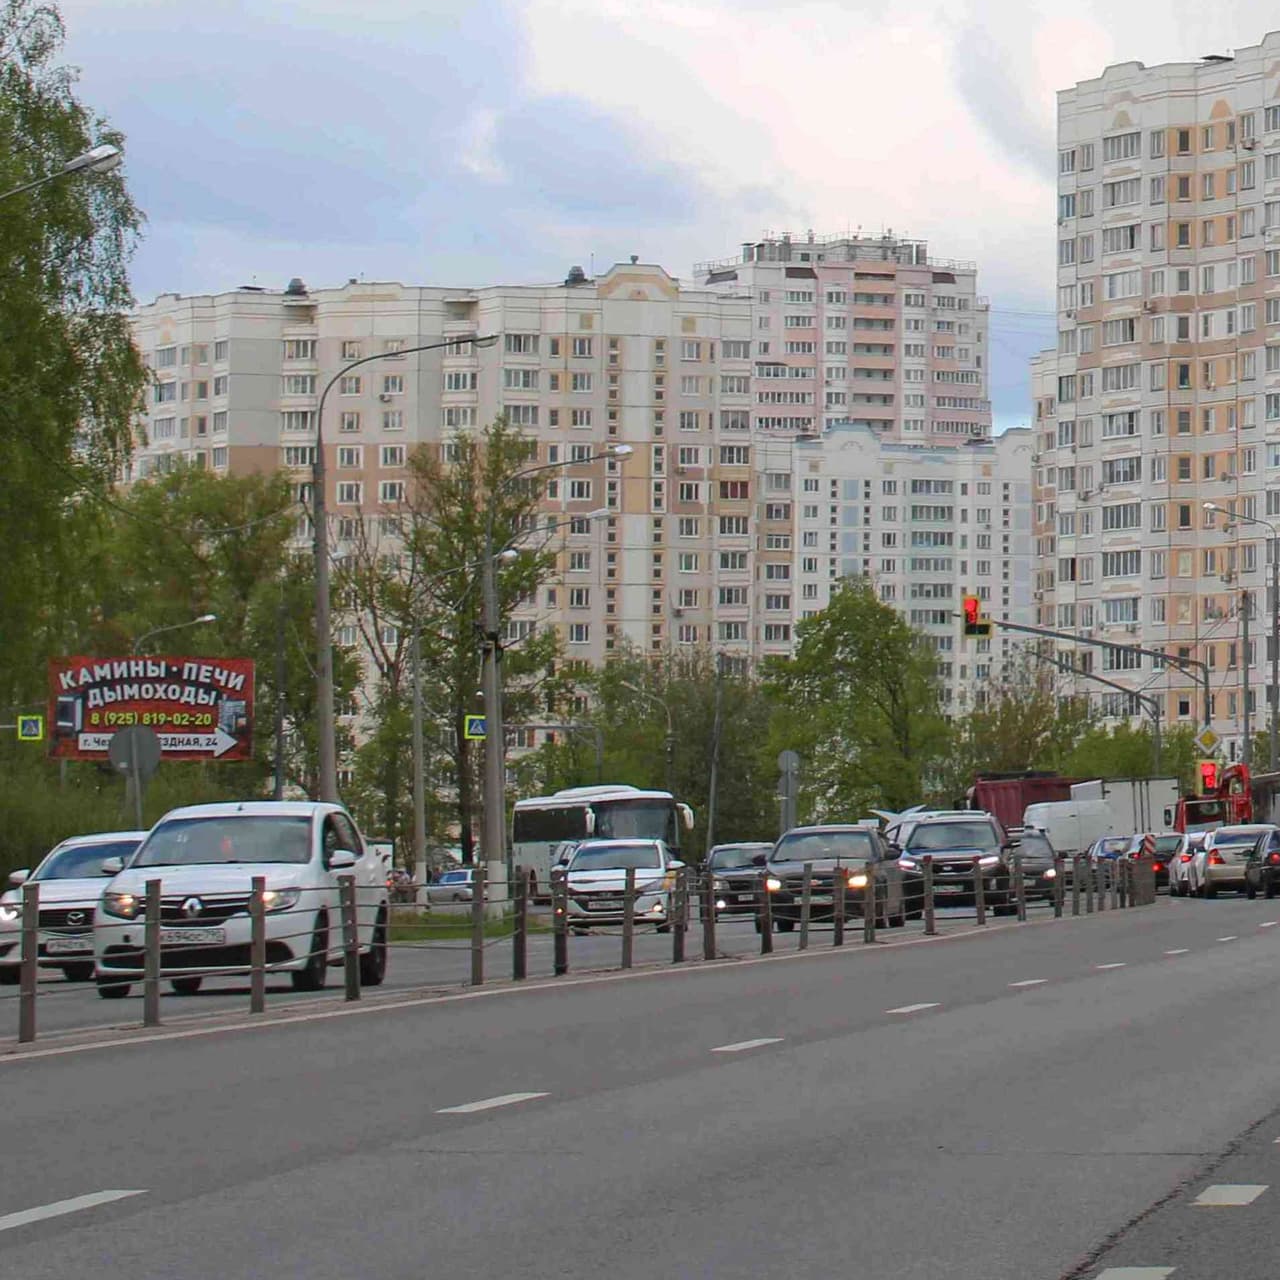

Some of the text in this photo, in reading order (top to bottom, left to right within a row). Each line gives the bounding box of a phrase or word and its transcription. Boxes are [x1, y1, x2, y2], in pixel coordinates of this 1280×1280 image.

[59, 660, 246, 691] КАМИНЫ ПЕЧИ
[87, 683, 217, 708] ДЫМОХОДЫ
[91, 711, 213, 726] 8 (925) 819-02-20
